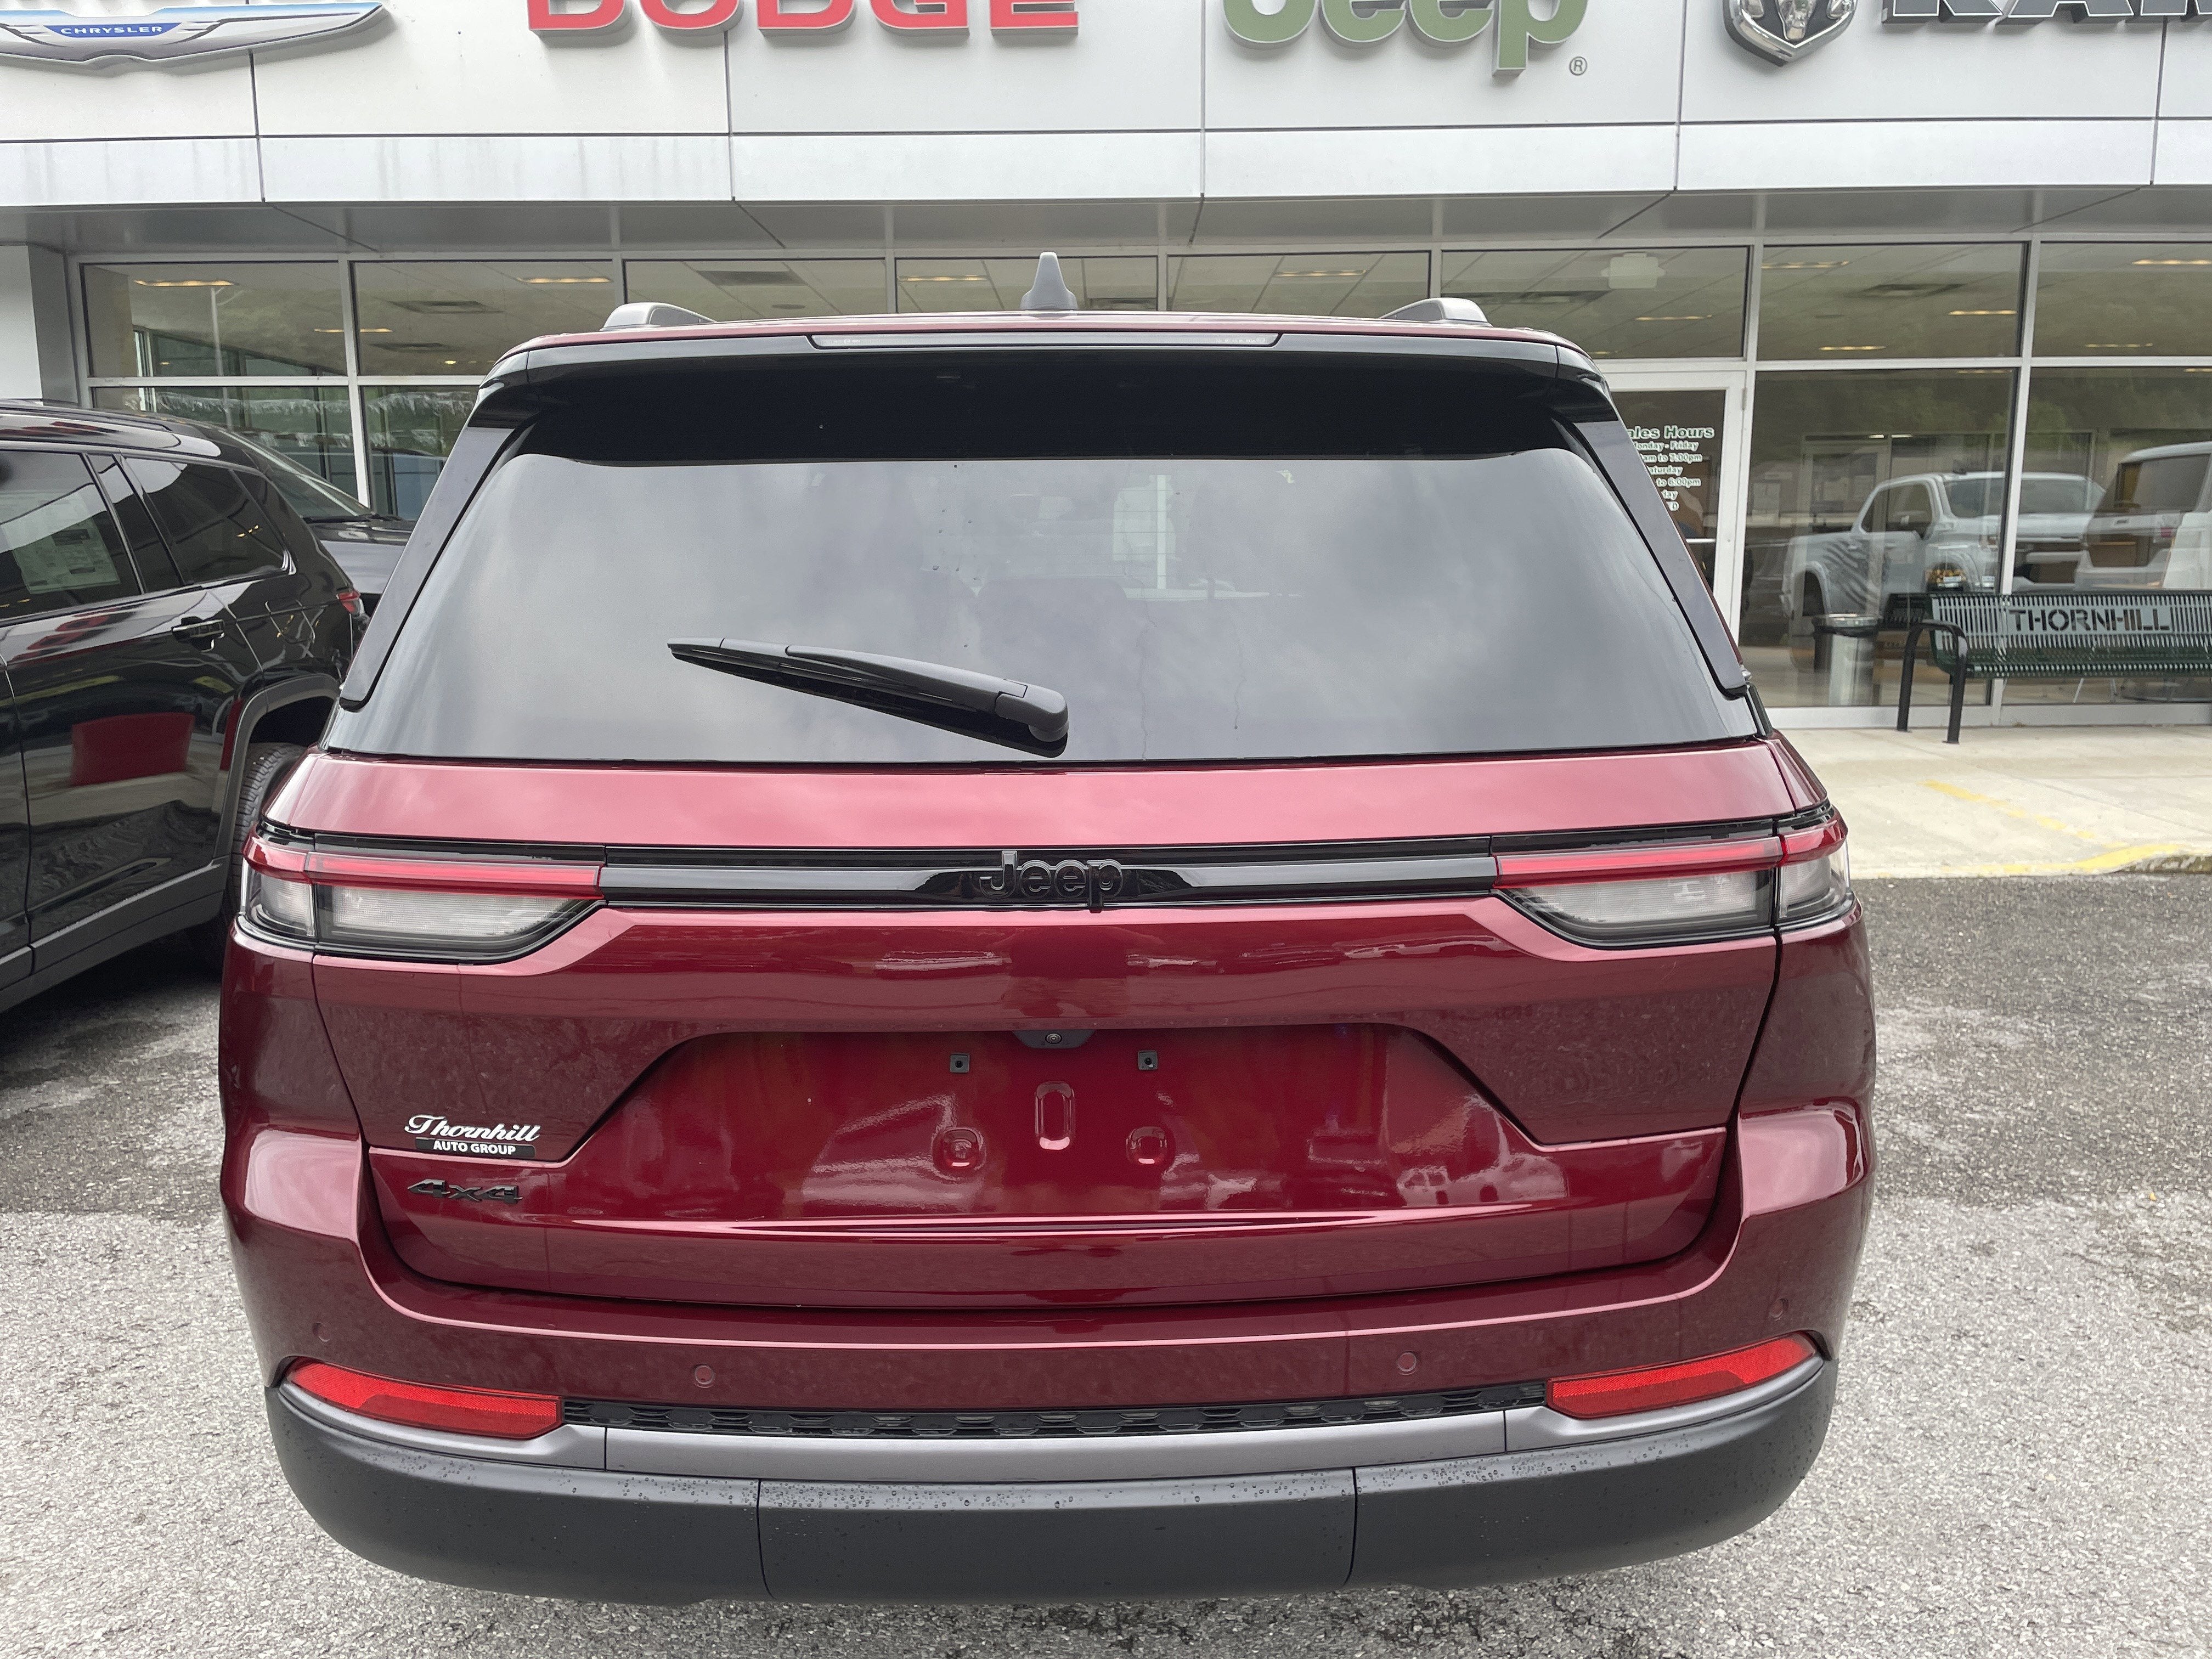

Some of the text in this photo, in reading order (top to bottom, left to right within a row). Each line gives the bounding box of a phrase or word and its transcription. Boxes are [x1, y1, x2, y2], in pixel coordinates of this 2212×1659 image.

[60, 26, 162, 35] CHRYSLER
[1627, 425, 1715, 439] ales Hours
[1670, 441, 1699, 452] Friday
[1657, 453, 1668, 462] to
[1647, 465, 1684, 476] aturday
[1656, 478, 1667, 487] to
[2008, 609, 2170, 632] THORNHILL
[979, 850, 1122, 913] Jeep
[404, 1114, 541, 1142] Thornhill
[433, 1140, 516, 1155] AUTO GROUP
